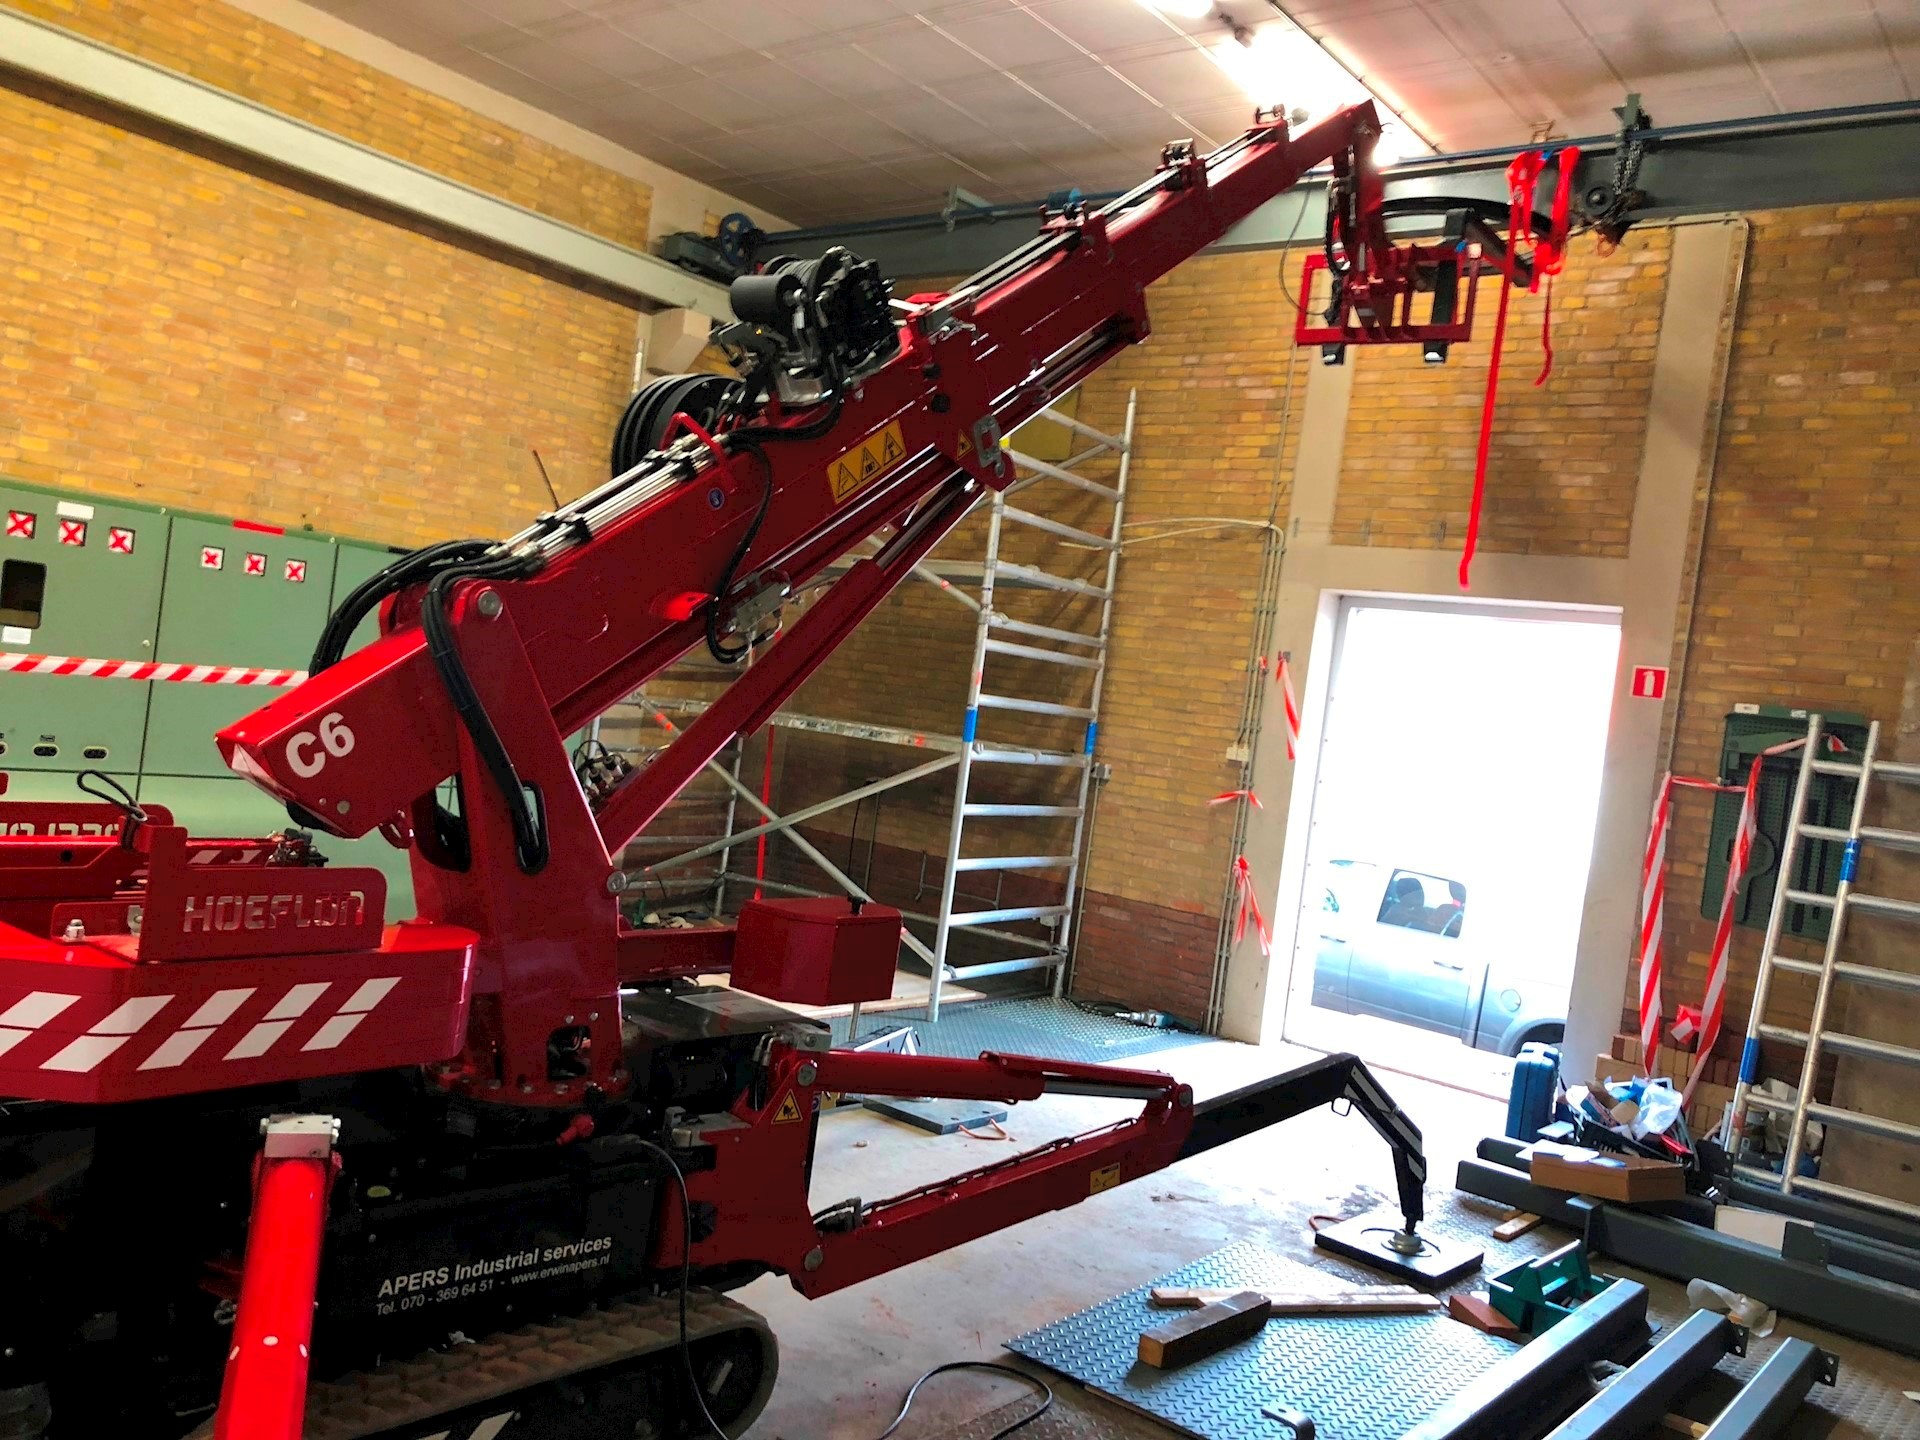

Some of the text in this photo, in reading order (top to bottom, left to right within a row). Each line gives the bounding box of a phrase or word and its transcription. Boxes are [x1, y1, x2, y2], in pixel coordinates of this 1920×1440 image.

[285, 711, 355, 778] C6
[183, 890, 365, 933] HOEFLON
[376, 1302, 397, 1316] Tel.
[401, 1294, 425, 1310] 070
[436, 1286, 459, 1302] 369
[461, 1282, 476, 1296] 64
[479, 1278, 494, 1292] 51
[510, 1253, 610, 1286] www.erwinapers.nl
[377, 1236, 612, 1298] APERS Industrial services
